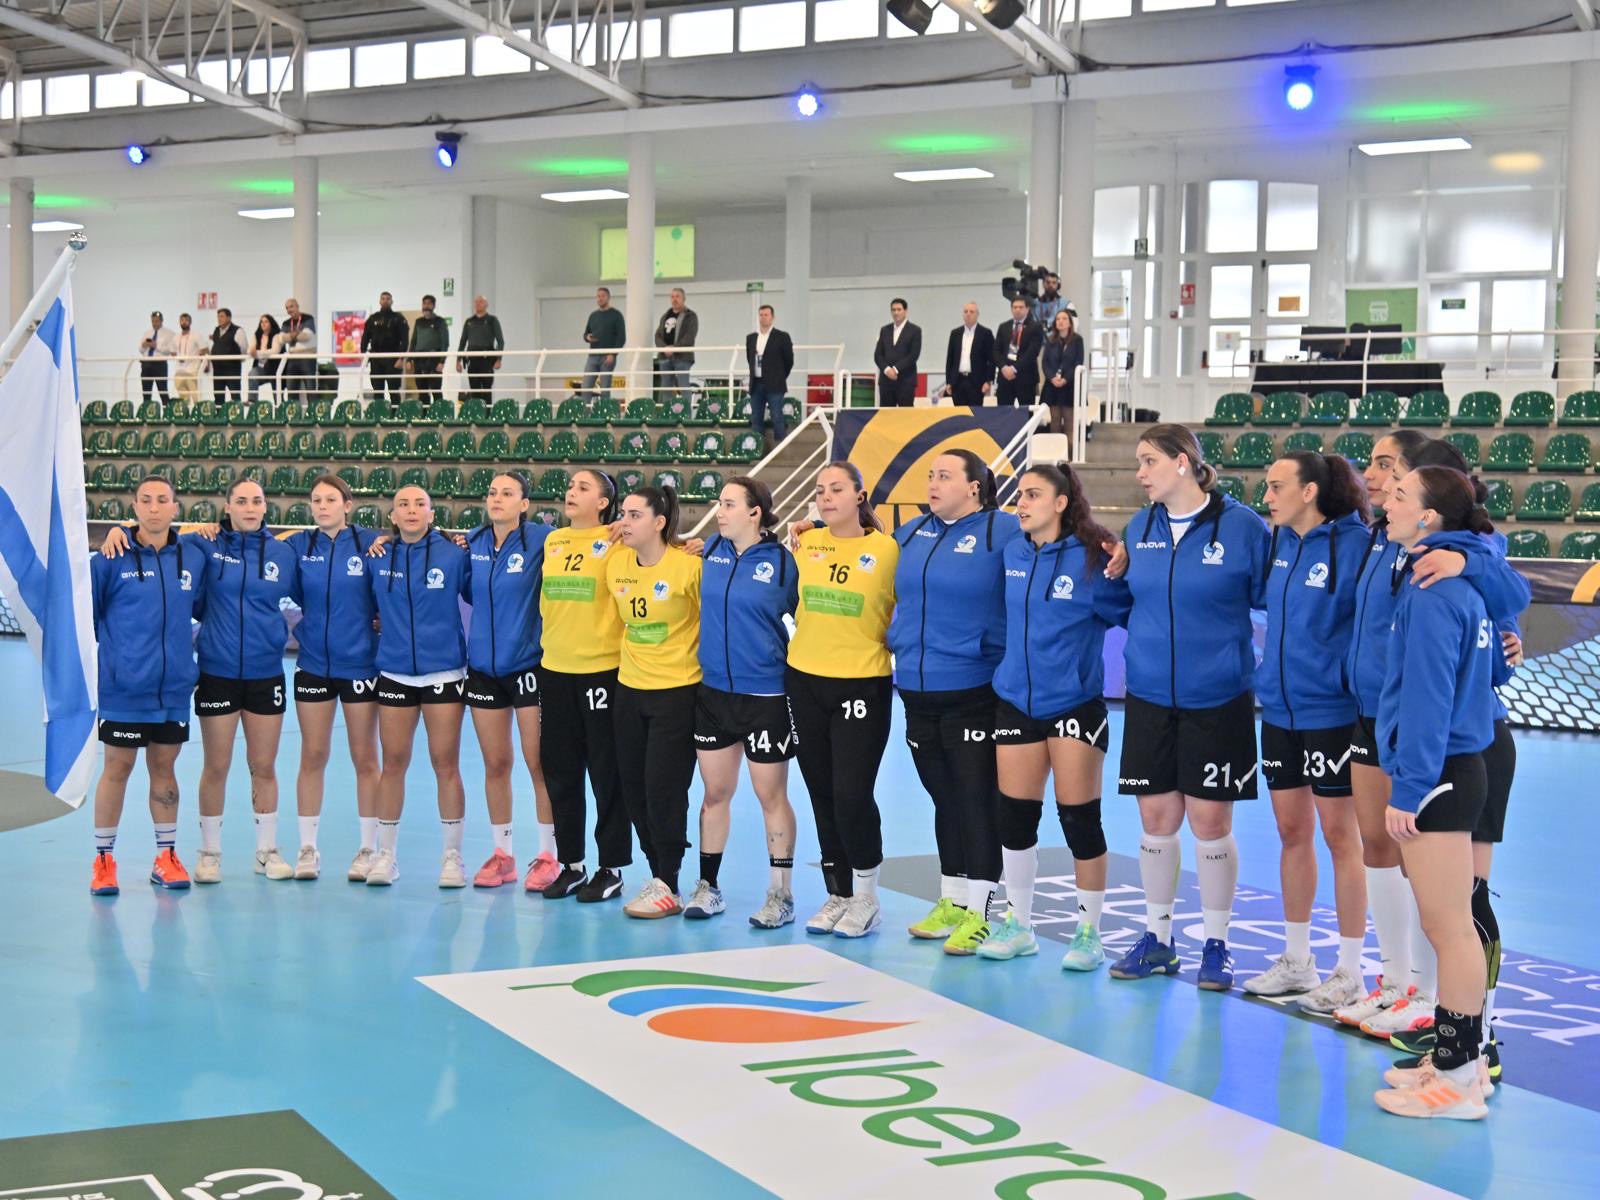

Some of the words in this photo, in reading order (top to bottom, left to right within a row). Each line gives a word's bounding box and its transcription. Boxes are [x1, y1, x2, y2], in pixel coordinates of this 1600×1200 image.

[1136, 541, 1167, 550] GIVOVA
[563, 553, 585, 572] 12
[707, 555, 731, 565] IVOVA
[828, 563, 851, 585] 16
[629, 597, 648, 618] 13
[297, 686, 328, 694] GIVOVA
[516, 672, 537, 695] 10
[273, 685, 283, 707] 5
[585, 687, 609, 710] 12
[841, 699, 867, 720] 16
[113, 731, 141, 739] GIVOVA
[1054, 718, 1081, 738] 19
[748, 730, 772, 753] 14
[1303, 749, 1326, 778] 23
[1203, 762, 1231, 788] 21
